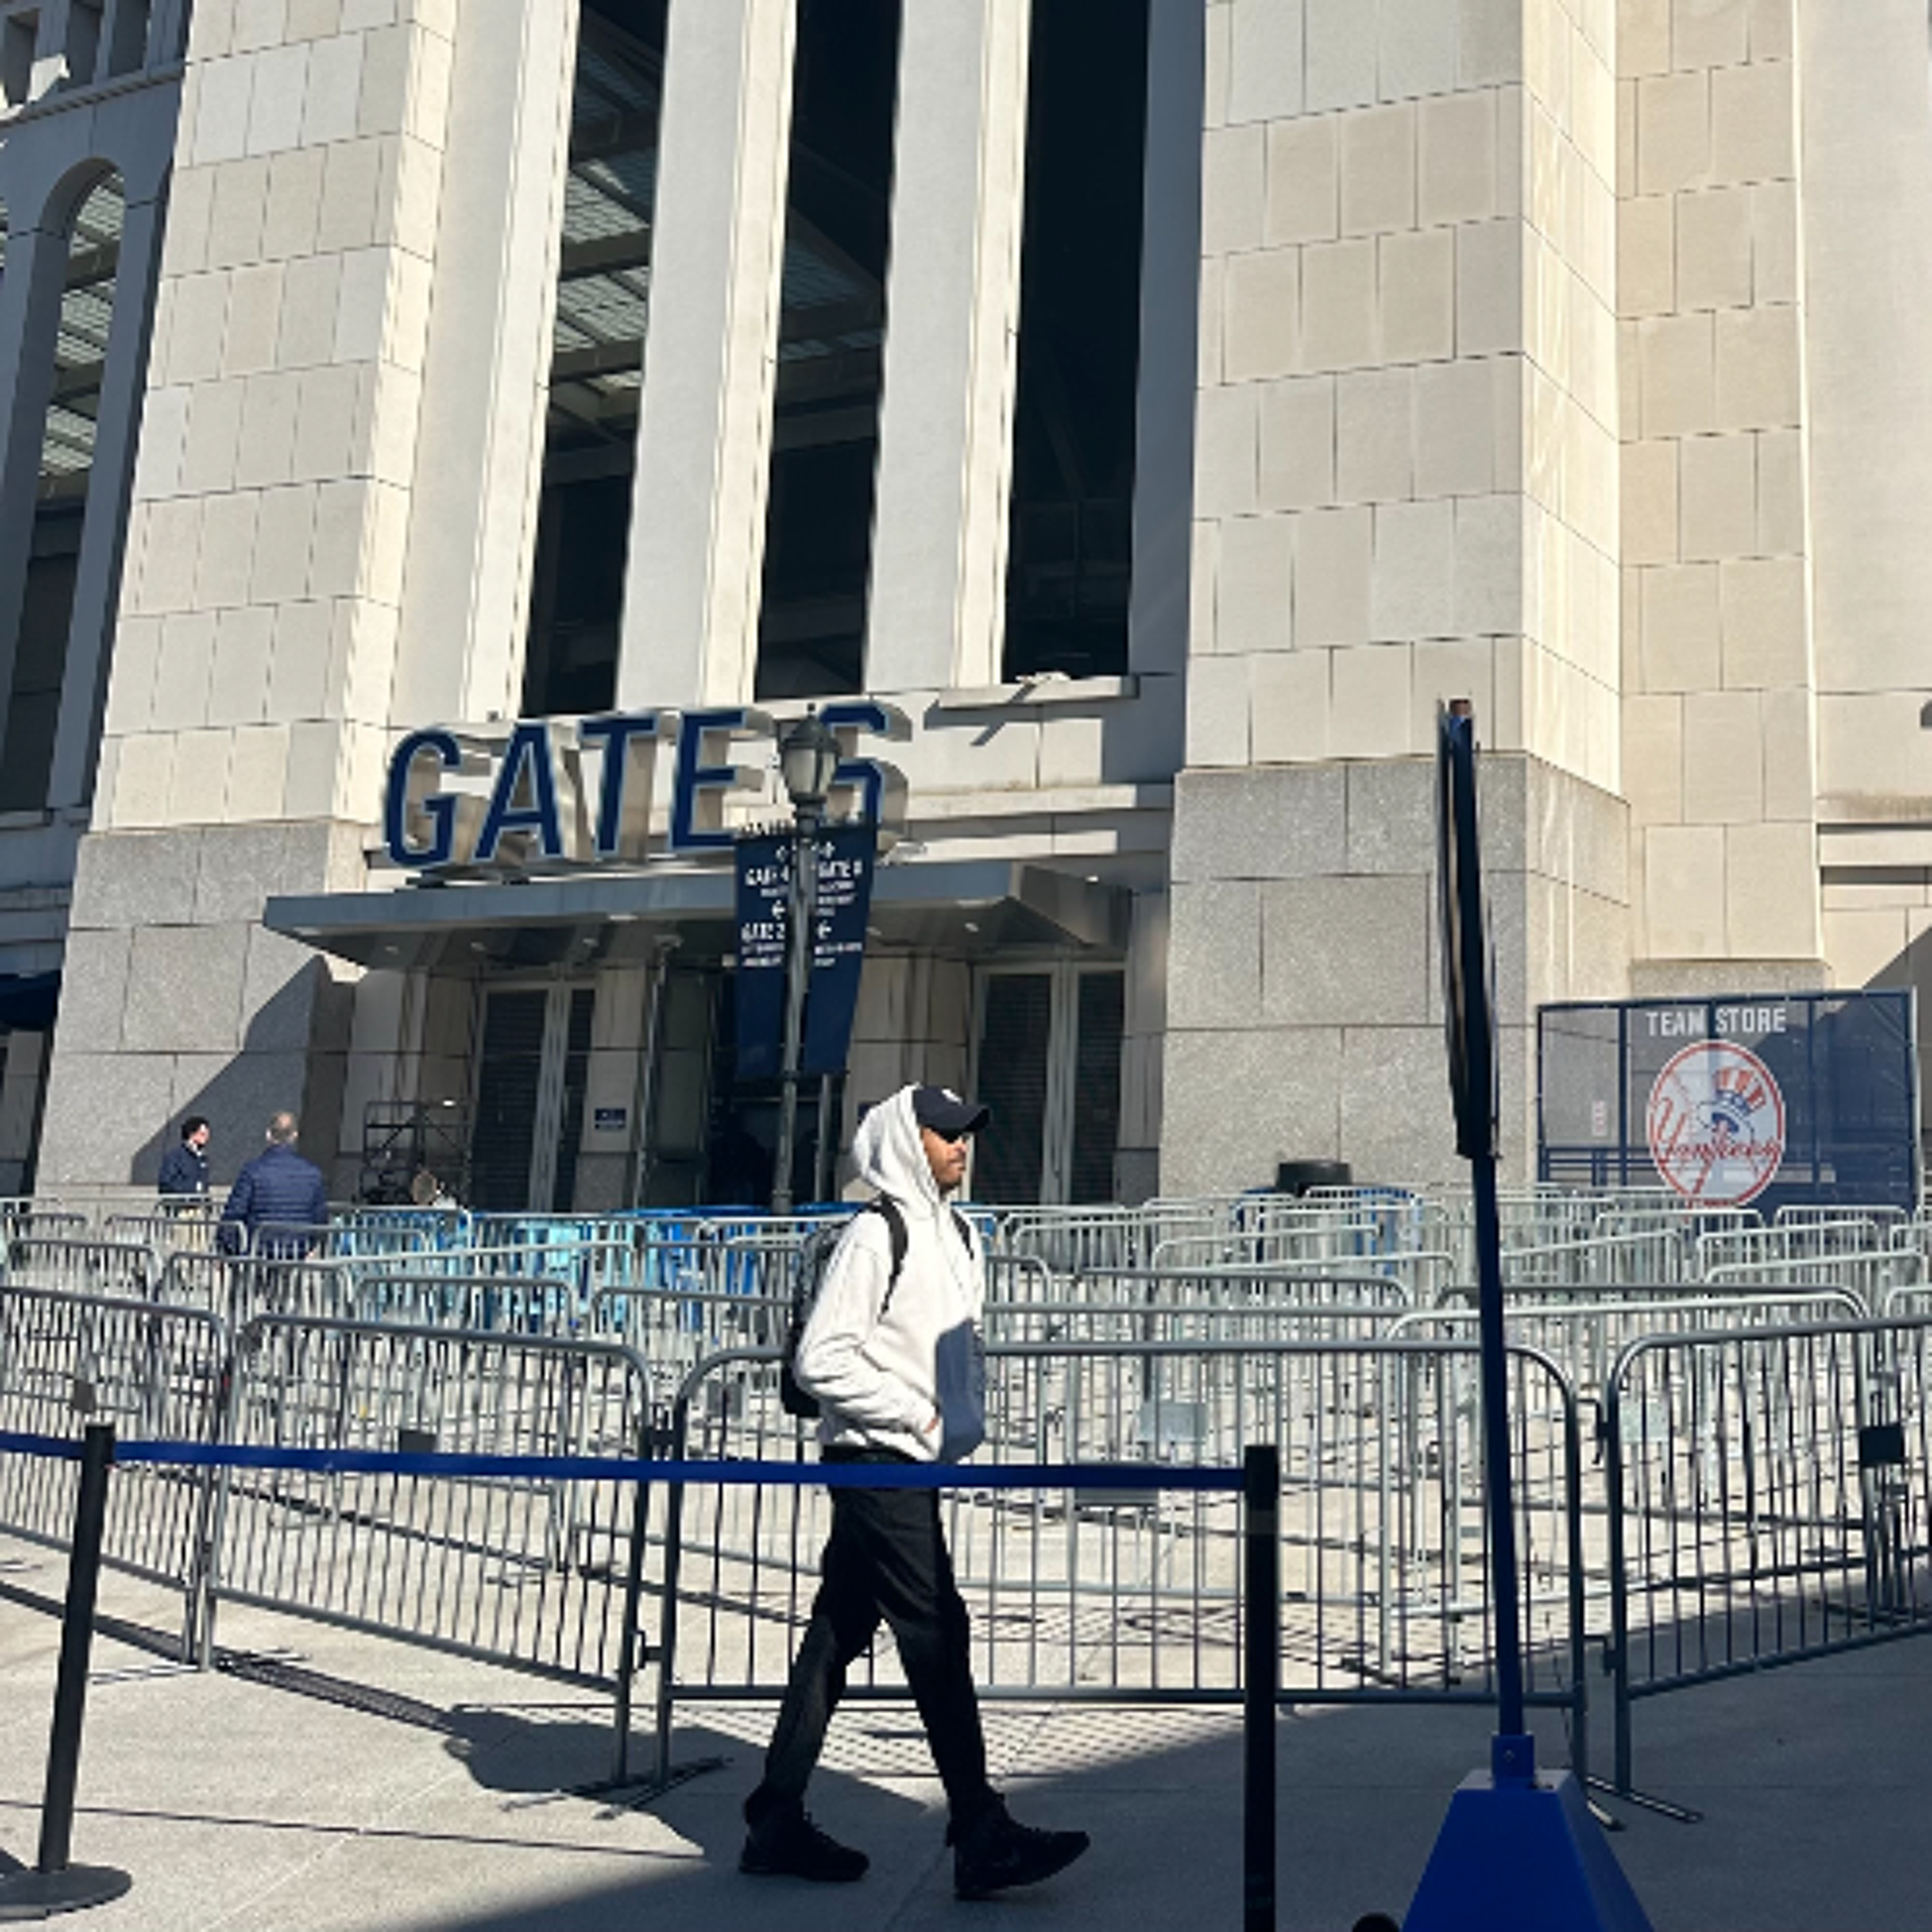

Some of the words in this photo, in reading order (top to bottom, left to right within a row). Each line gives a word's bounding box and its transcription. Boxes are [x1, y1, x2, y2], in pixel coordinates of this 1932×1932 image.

[384, 706, 747, 867] GATE
[815, 703, 888, 822] 6
[1645, 1009, 1705, 1036] TEAM
[1715, 1006, 1786, 1033] STORE
